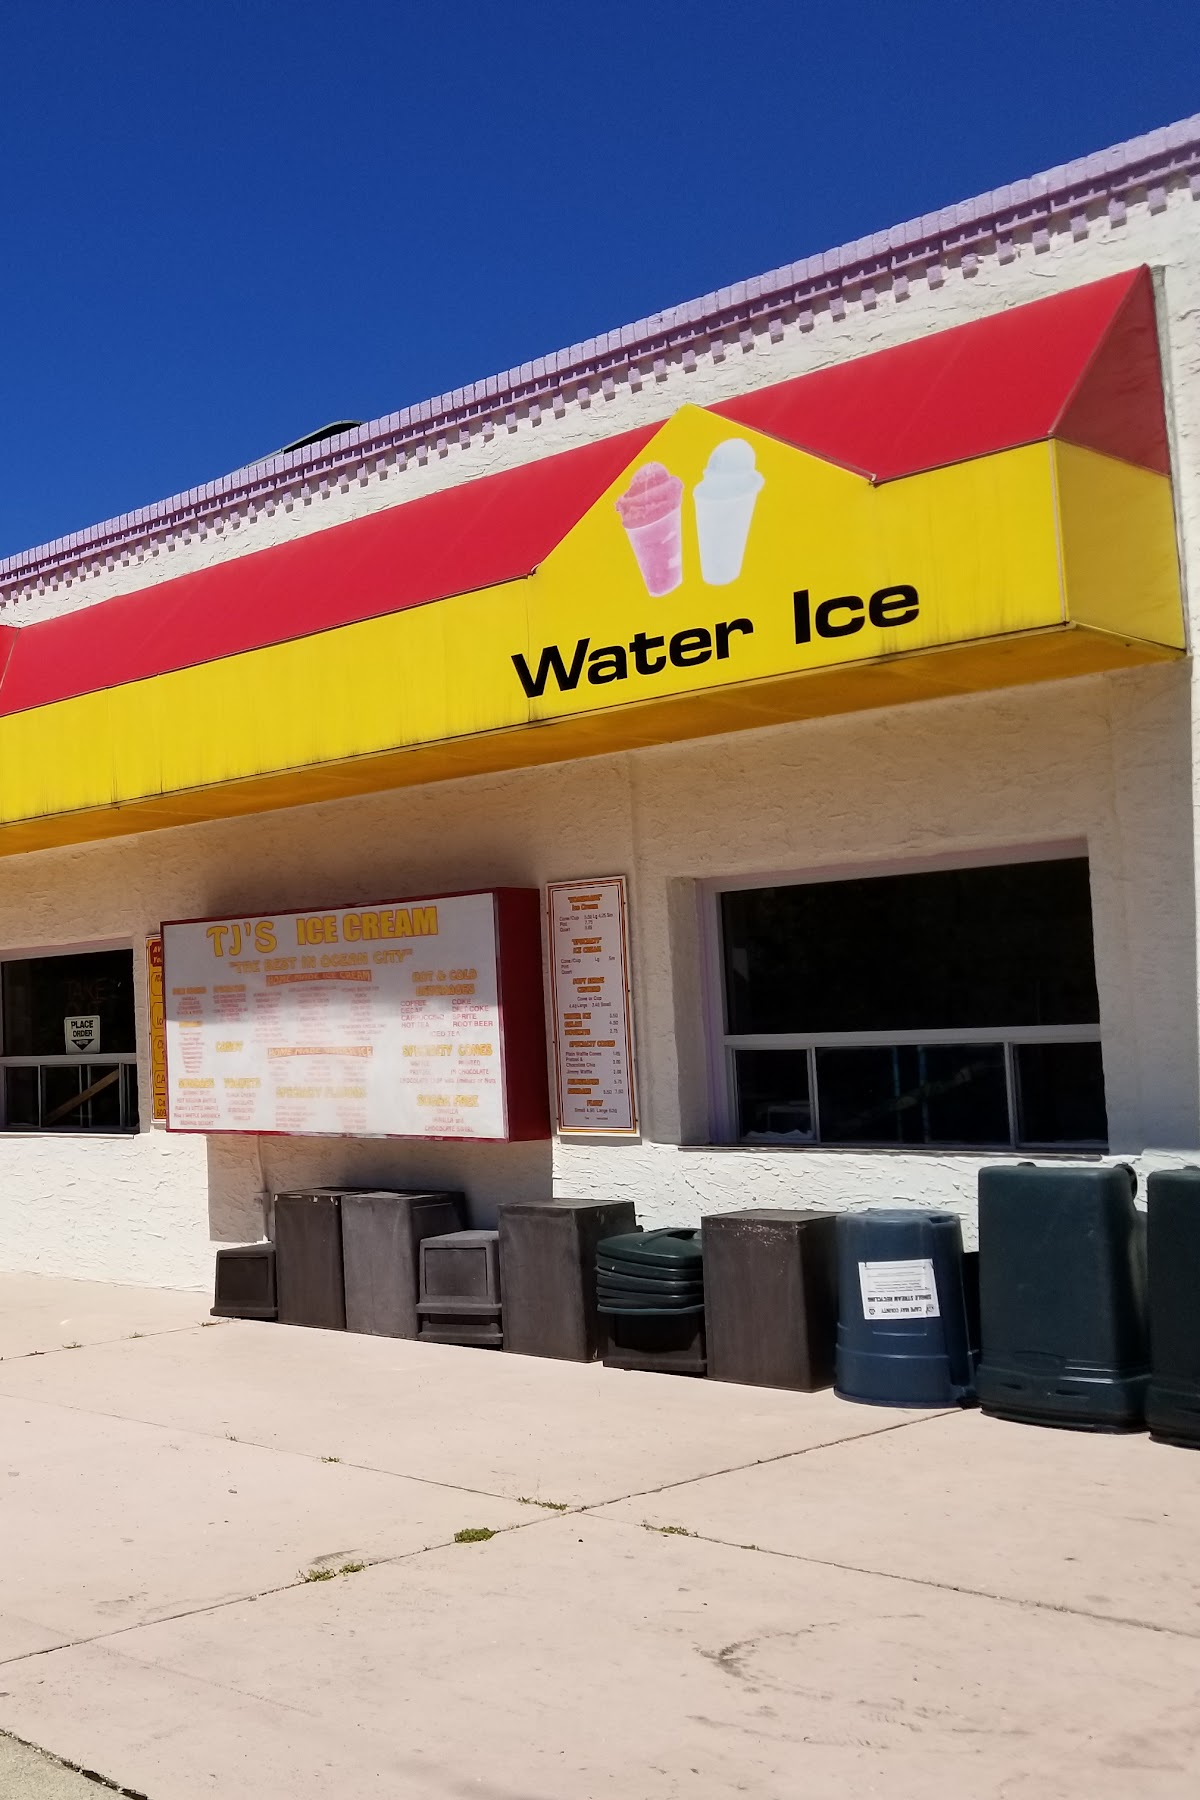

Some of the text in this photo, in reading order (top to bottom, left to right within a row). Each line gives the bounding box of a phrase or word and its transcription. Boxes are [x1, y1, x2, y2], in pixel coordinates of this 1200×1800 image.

[511, 584, 920, 698] Water Ice
[207, 906, 439, 957] TJ'S ICE CREAM
[264, 956, 297, 971] BEST
[301, 955, 317, 968] IN
[320, 952, 368, 967] OCEAN
[267, 970, 370, 984] HOME MADE ICE CREAM
[412, 970, 433, 982] HOT
[449, 968, 478, 980] COLD
[416, 984, 475, 996] BEVERAGES
[71, 1020, 93, 1029] PLACE
[448, 1029, 460, 1037] TEA
[268, 1048, 293, 1058] HOME
[358, 1046, 373, 1057] ICE
[402, 1042, 493, 1057] SPECIALTY CONES
